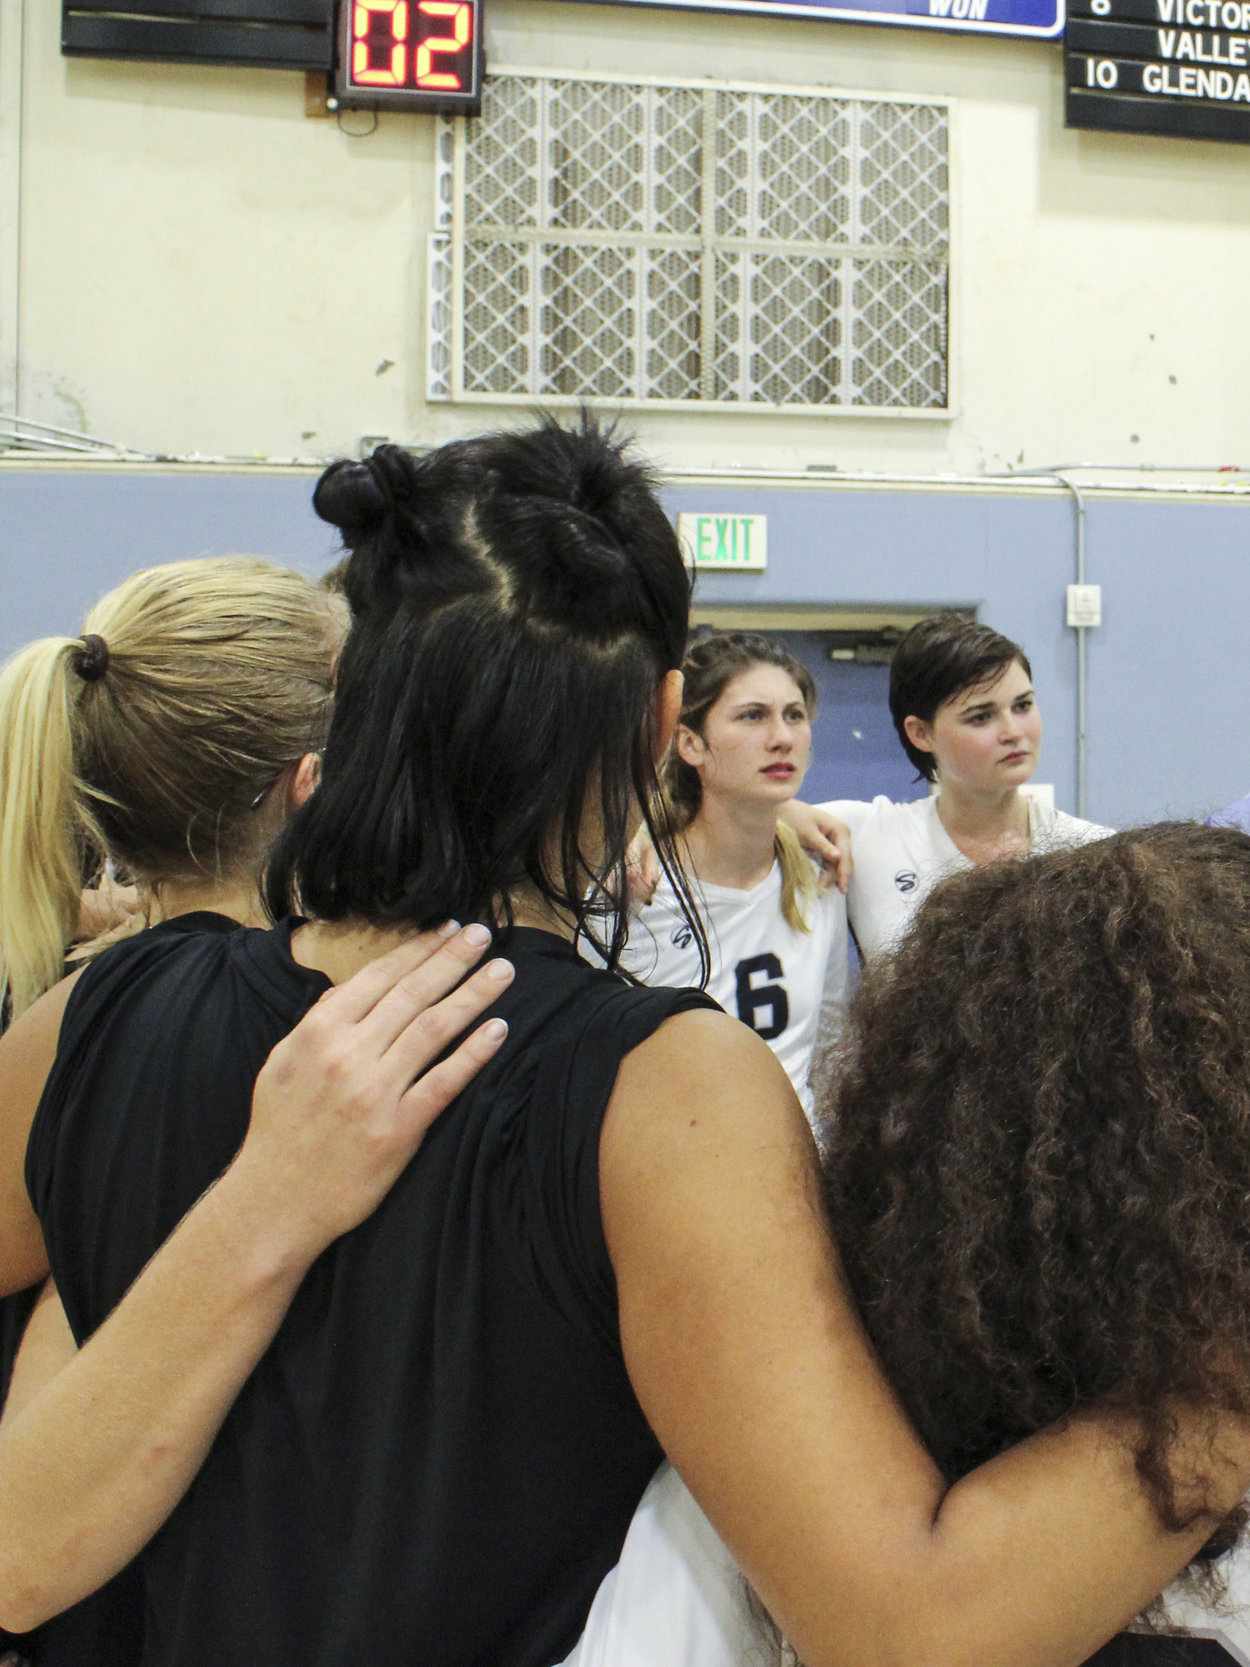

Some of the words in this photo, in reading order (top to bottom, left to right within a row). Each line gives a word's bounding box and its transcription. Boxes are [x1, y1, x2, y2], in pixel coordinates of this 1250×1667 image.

[352, 0, 472, 90] 02
[1086, 58, 1118, 89] 10
[697, 518, 754, 561] EXIT
[735, 953, 789, 1041] 6
